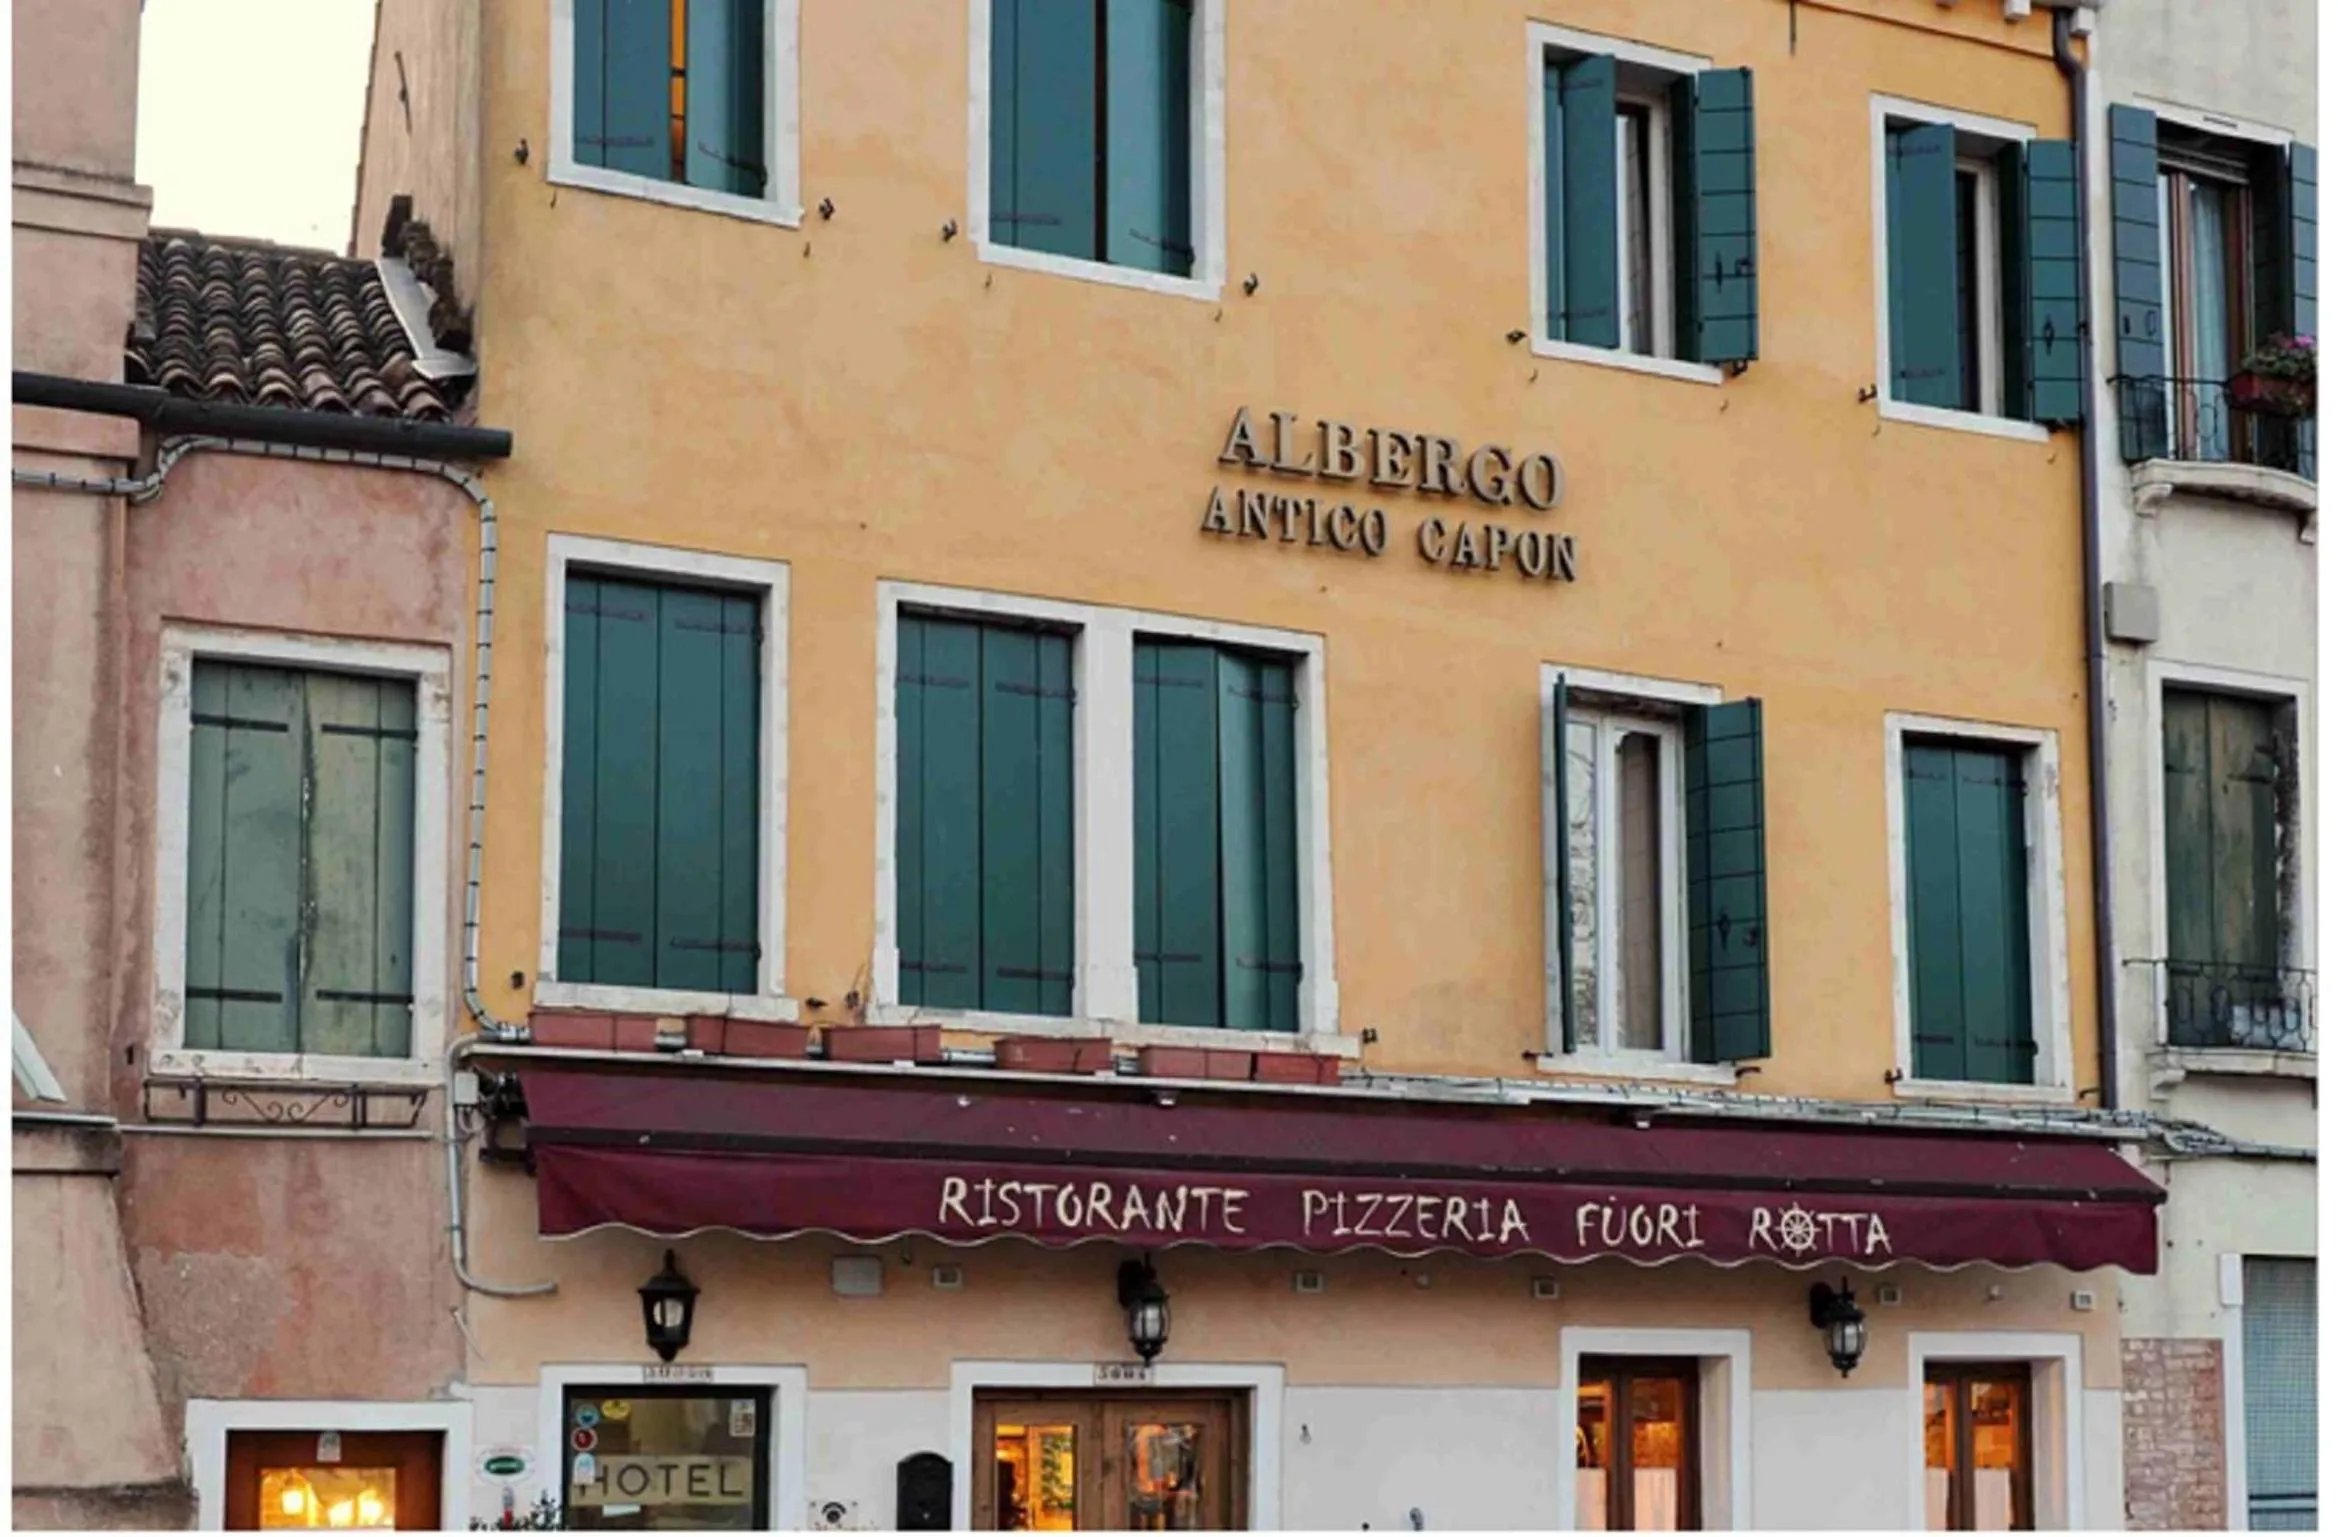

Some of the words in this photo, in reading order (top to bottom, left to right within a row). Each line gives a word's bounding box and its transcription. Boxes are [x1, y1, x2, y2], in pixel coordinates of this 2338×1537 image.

[1217, 405, 1565, 509] ALBERGO
[1200, 485, 1388, 556] ANTICO
[1417, 516, 1579, 581] CAPON
[938, 1176, 1249, 1233] RISTORANTE
[1303, 1189, 1530, 1243] PIZZERIA
[574, 1463, 744, 1497] HOTEL
